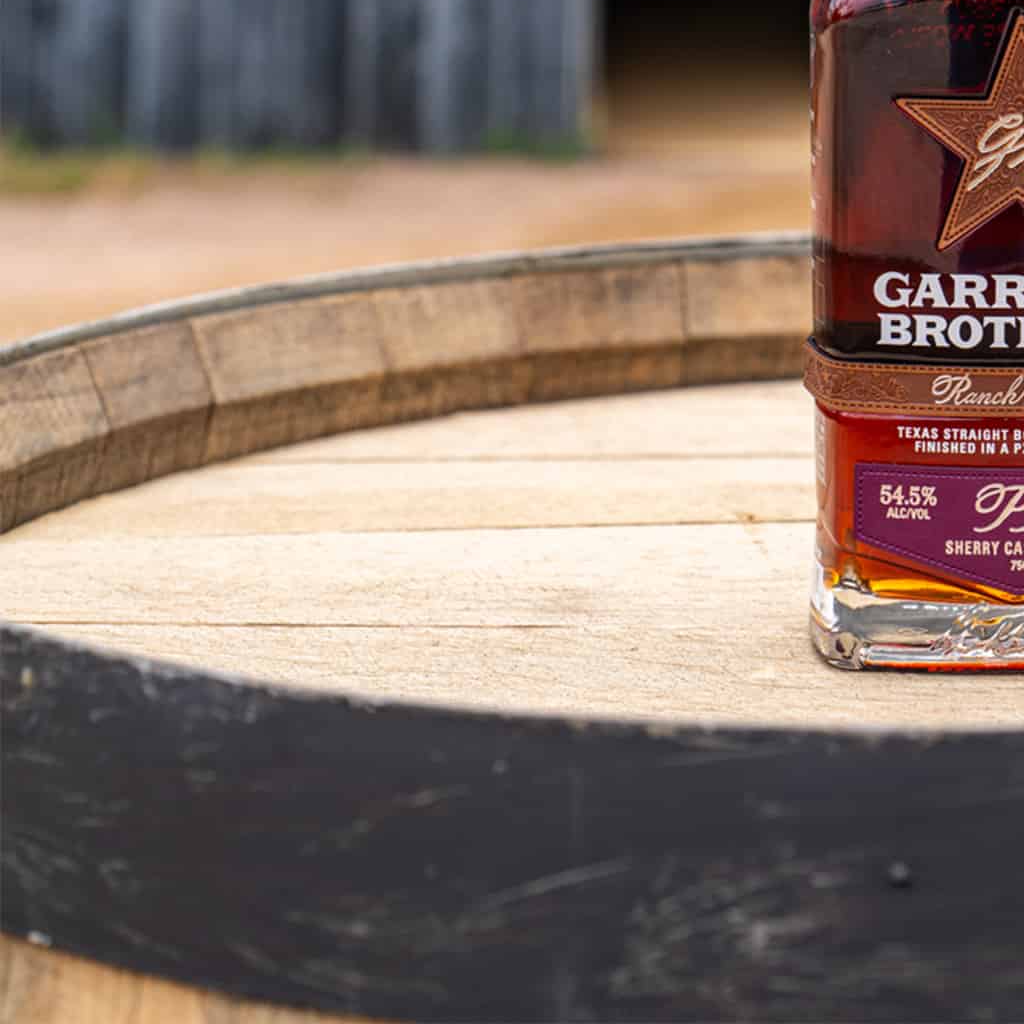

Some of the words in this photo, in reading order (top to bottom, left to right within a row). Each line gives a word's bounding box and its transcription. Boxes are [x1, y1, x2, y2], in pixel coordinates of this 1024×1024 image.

[931, 374, 1024, 406] Ranch
[897, 426, 939, 440] TEXAS
[943, 428, 1009, 442] STRAIGHT
[914, 441, 976, 454] FINISHED
[981, 442, 996, 455] IN
[1000, 442, 1010, 455] A
[880, 484, 938, 507] 54.5%
[886, 507, 931, 521] ALC/VOL
[945, 540, 1000, 556] SHERRY
